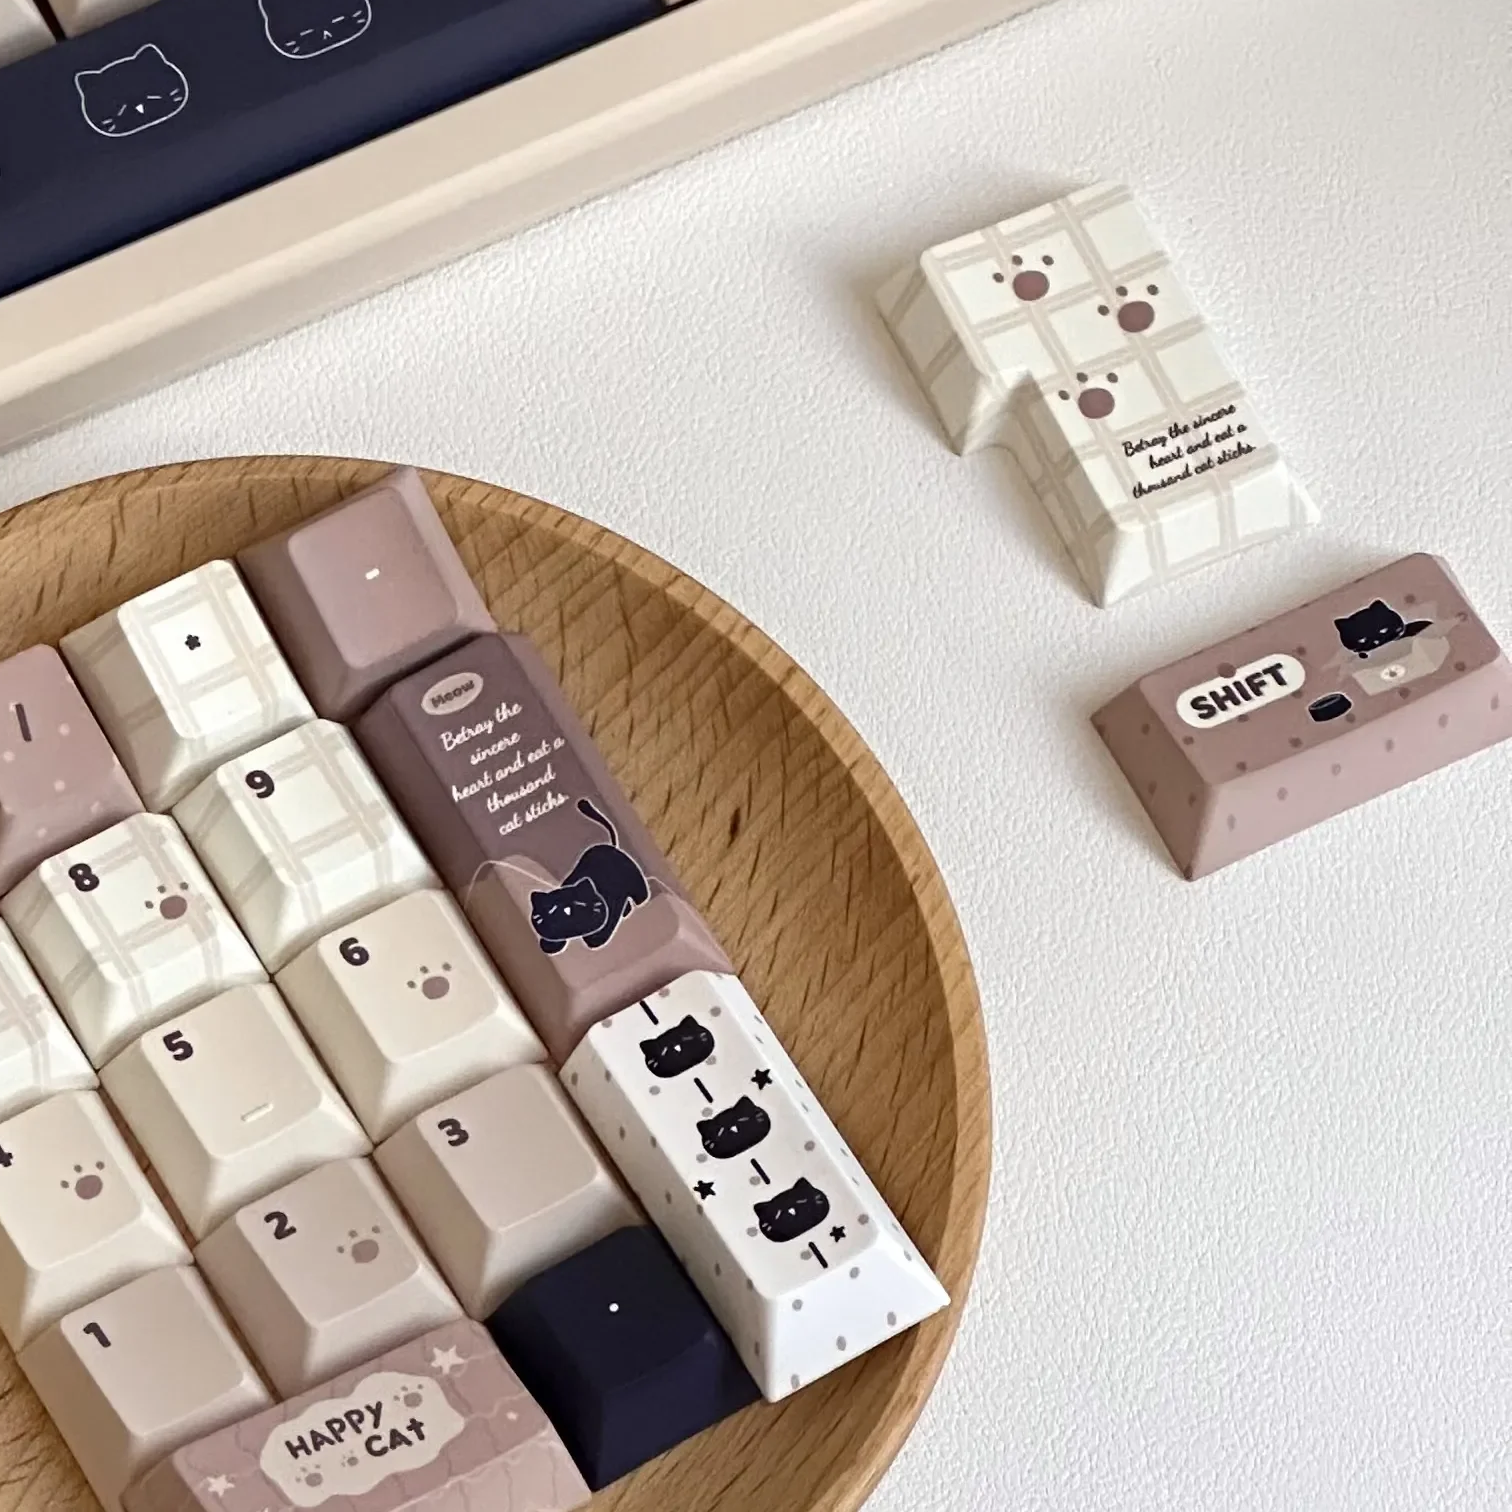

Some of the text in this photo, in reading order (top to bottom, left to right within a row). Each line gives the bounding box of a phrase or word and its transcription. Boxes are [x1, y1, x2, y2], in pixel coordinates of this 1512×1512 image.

[432, 680, 474, 708] Meow
[1190, 662, 1287, 720] SHIFT
[245, 769, 275, 799] 9
[68, 863, 100, 893] 8
[338, 937, 370, 967] 6
[162, 1030, 194, 1062] 5
[437, 1118, 469, 1147] 3
[263, 1211, 297, 1241] 2
[82, 1322, 112, 1348] 1
[285, 1401, 383, 1460] HAPPY
